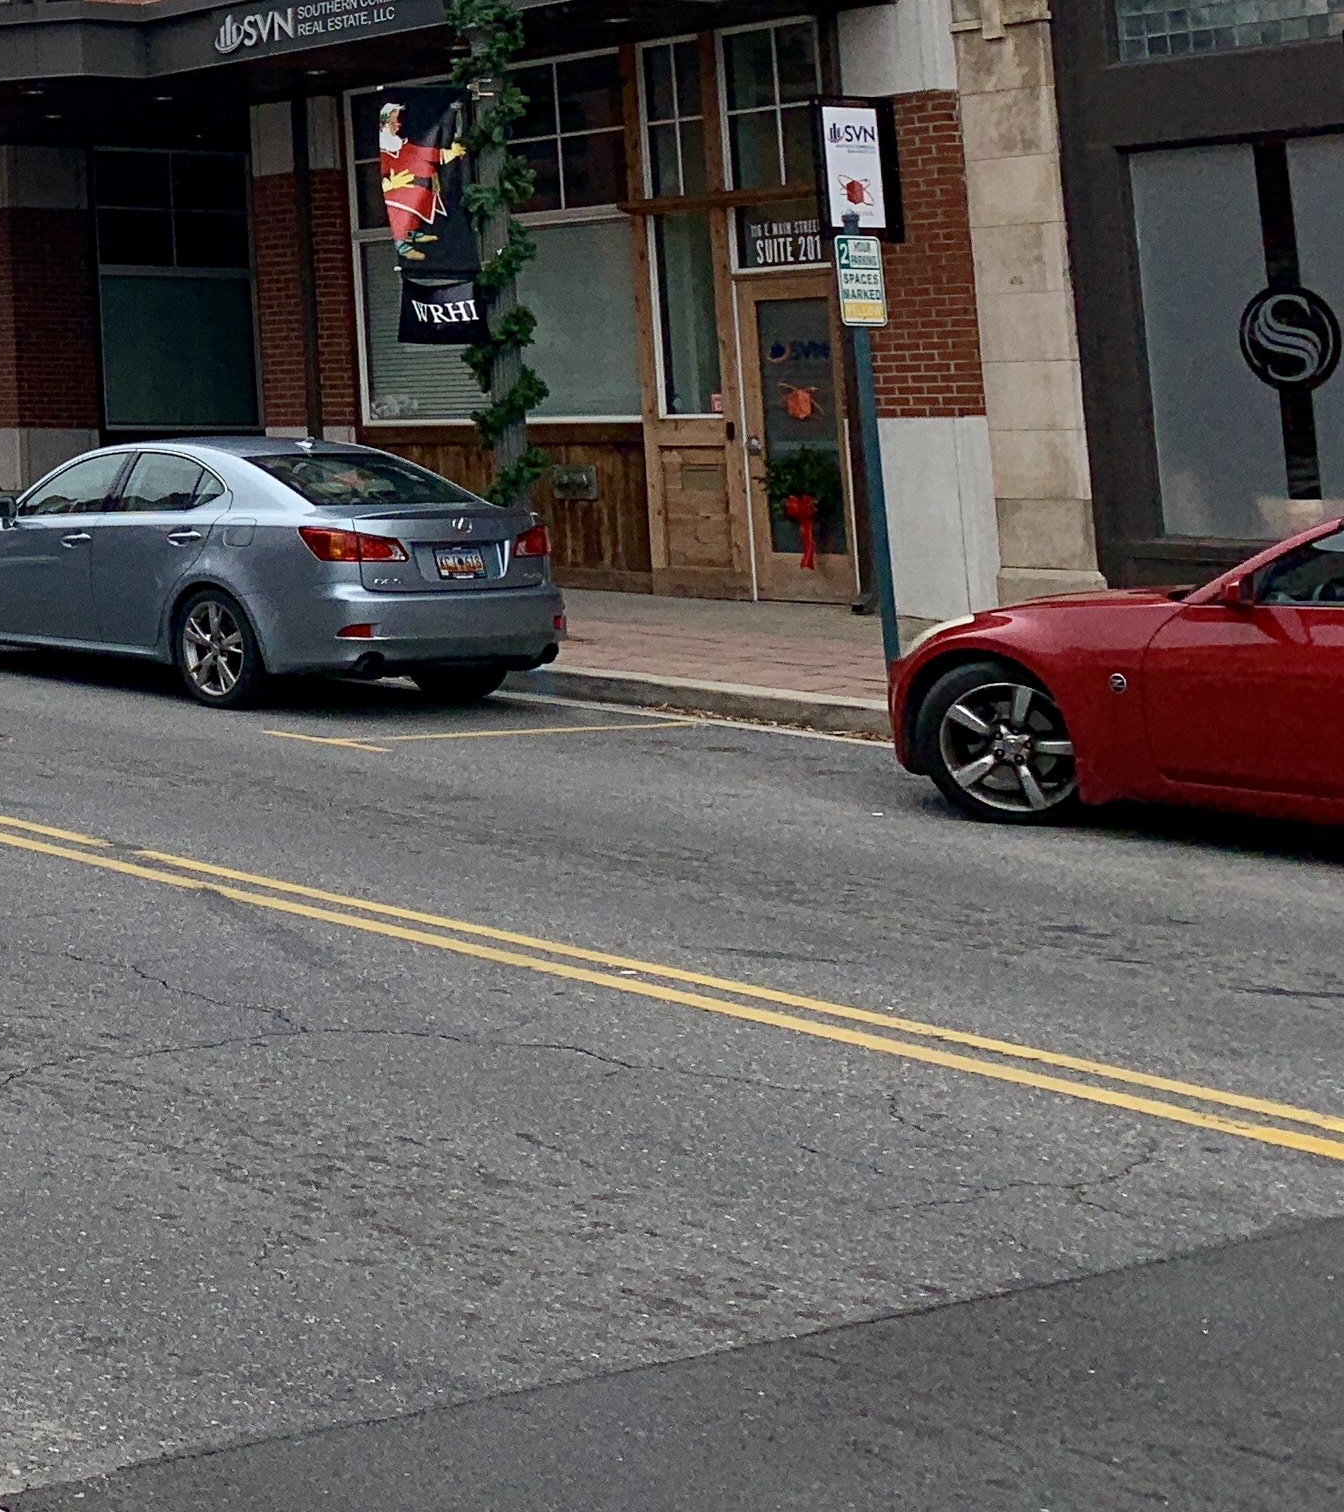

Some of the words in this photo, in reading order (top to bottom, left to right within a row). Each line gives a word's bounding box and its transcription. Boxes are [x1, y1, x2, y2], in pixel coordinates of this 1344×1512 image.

[243, 7, 295, 47] SVN
[297, 21, 326, 37] REAL
[327, 11, 372, 31] ESTATE,
[373, 6, 396, 23] LLC
[844, 124, 875, 142] SVN
[756, 237, 794, 264] SUITE
[798, 235, 822, 261] 201
[839, 243, 850, 265] 2
[843, 273, 879, 285] SPACES
[842, 289, 882, 300] MARKED
[411, 299, 479, 324] WRHI
